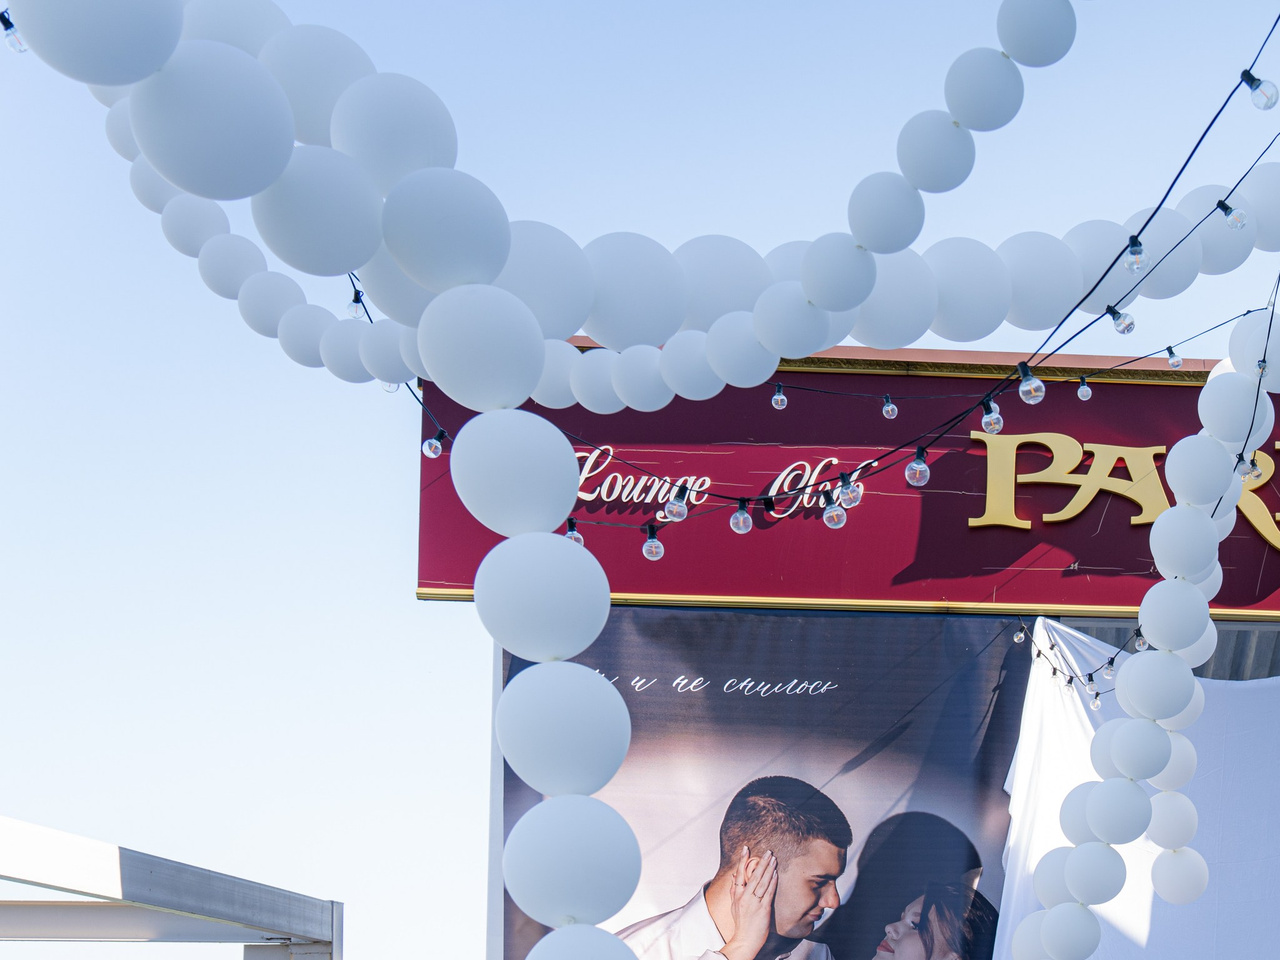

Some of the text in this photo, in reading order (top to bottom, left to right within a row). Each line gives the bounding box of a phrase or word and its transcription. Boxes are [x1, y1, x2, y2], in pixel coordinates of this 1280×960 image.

[575, 445, 878, 522] Lounge Club
[672, 675, 710, 693] не
[723, 677, 838, 698] снилось
